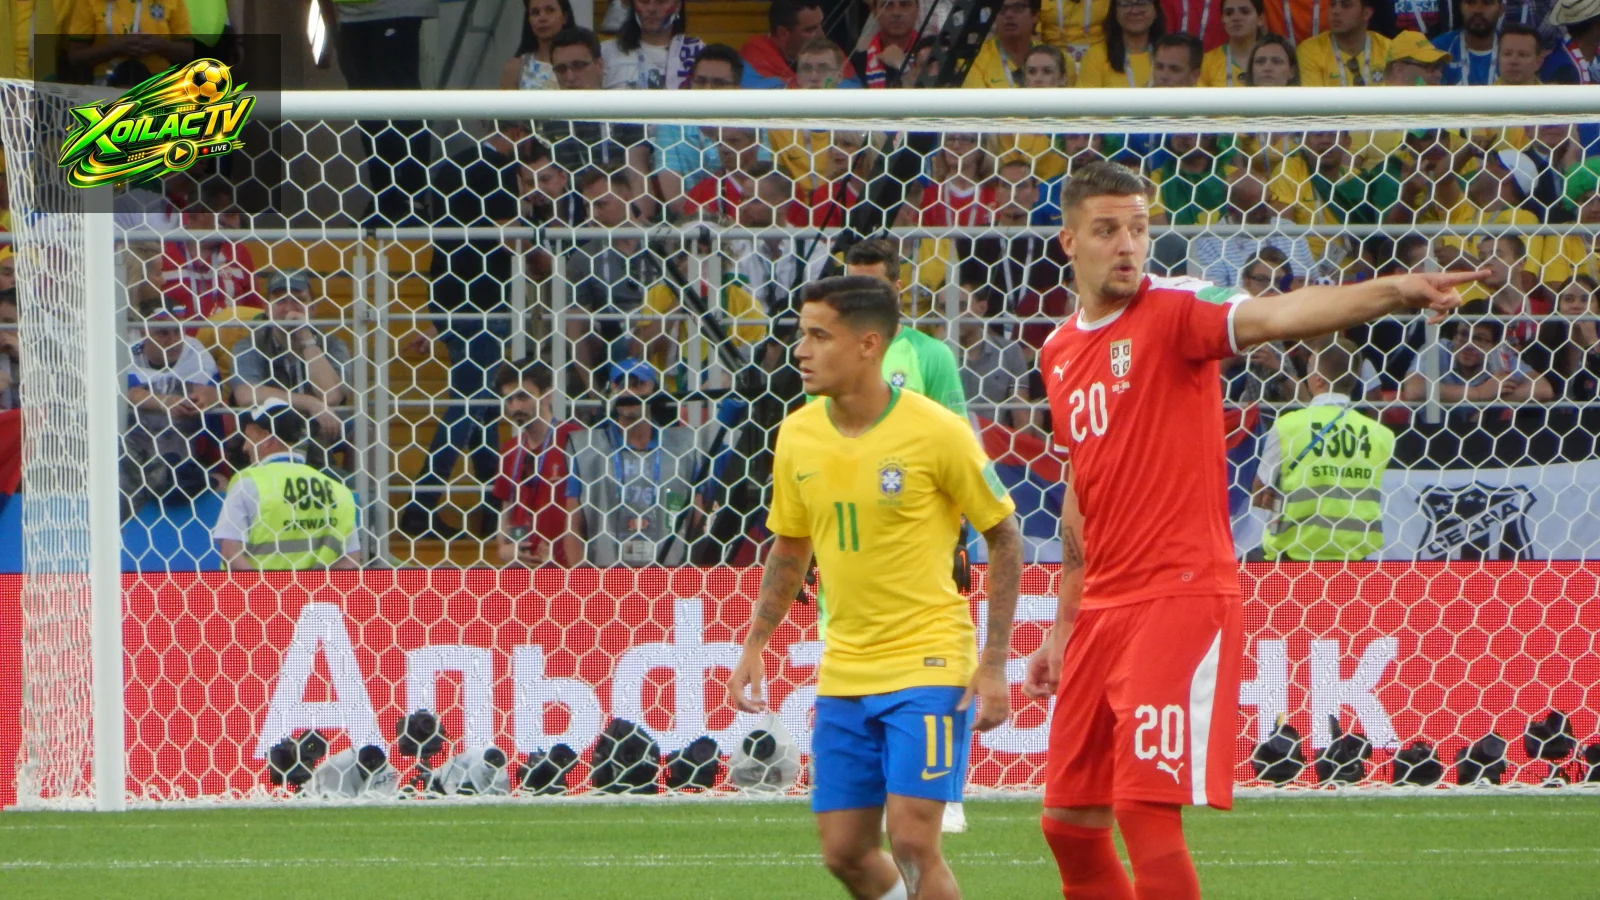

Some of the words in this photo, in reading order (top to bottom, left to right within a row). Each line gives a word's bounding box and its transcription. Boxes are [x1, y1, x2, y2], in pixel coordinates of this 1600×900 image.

[1069, 381, 1108, 442] 20
[1312, 465, 1372, 479] STEWARD
[834, 501, 860, 552] 11
[923, 714, 953, 768] 11
[1134, 704, 1185, 760] 20
